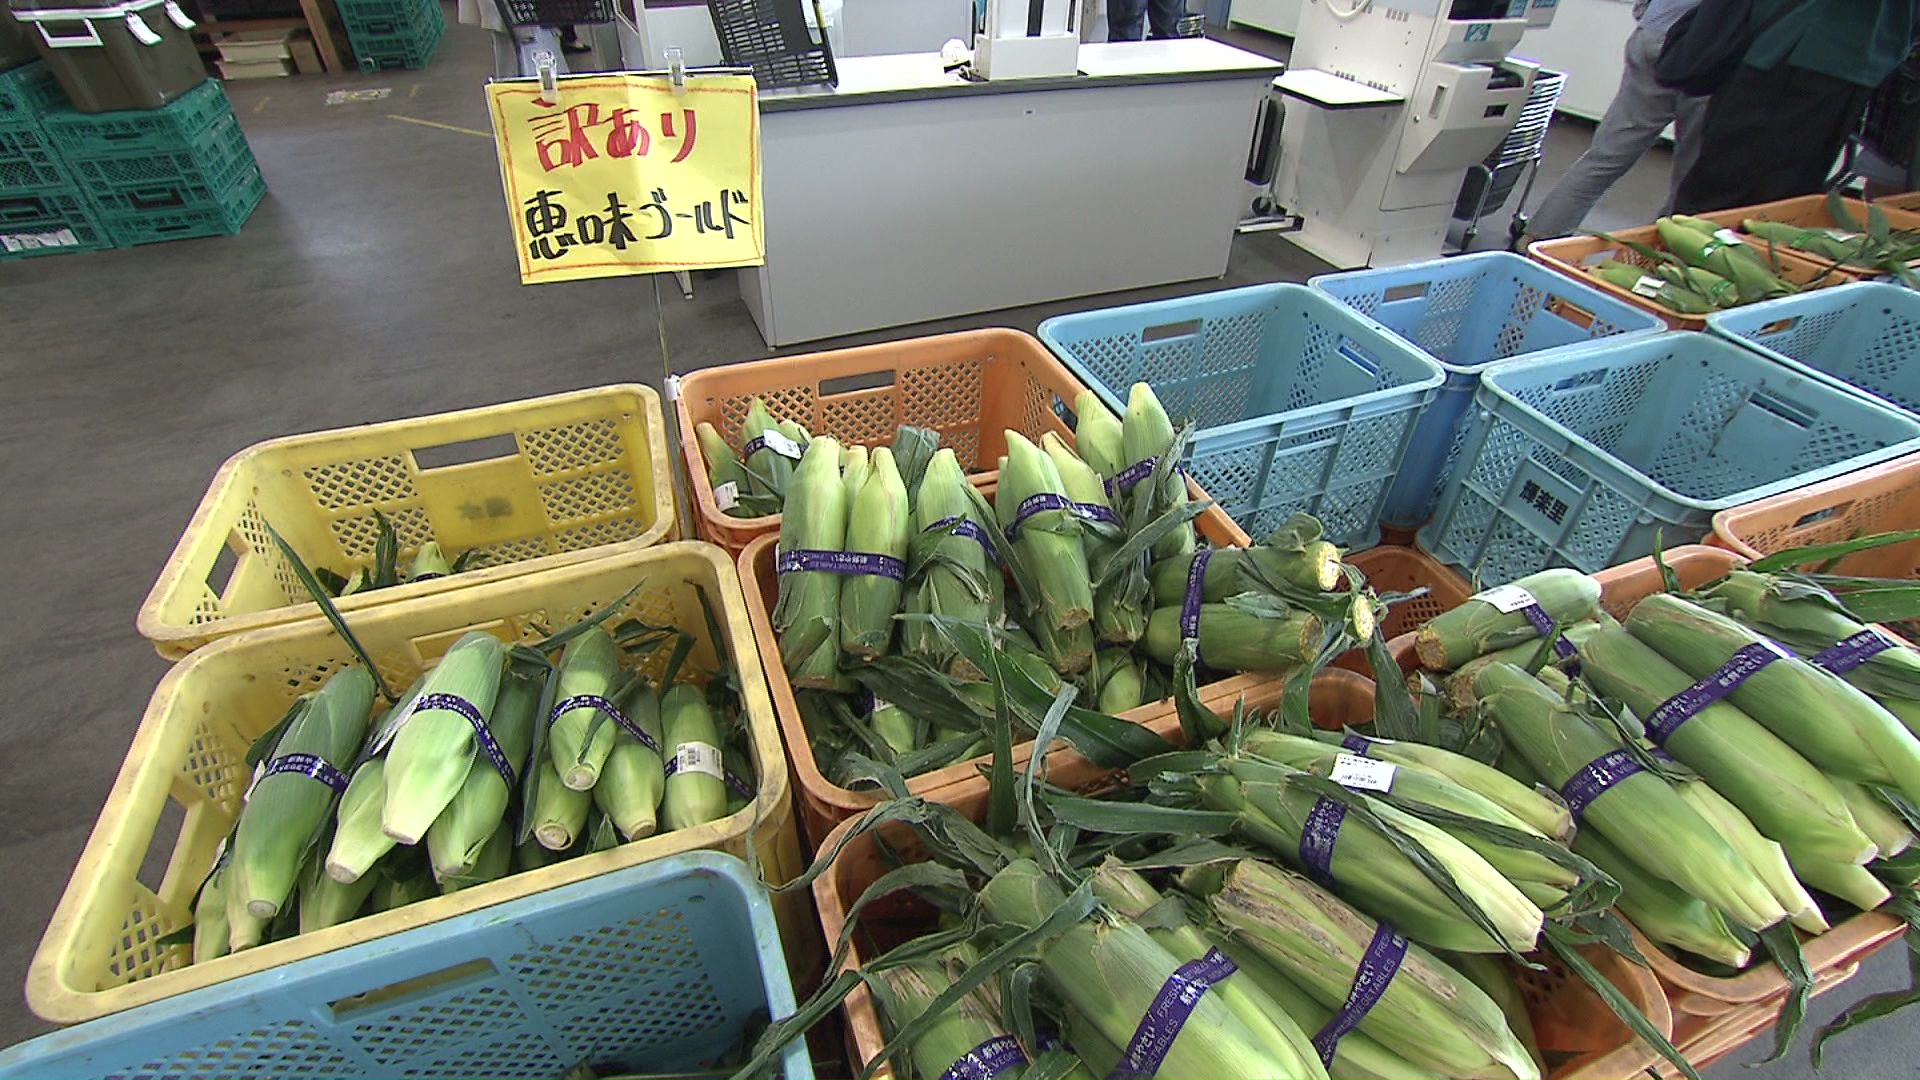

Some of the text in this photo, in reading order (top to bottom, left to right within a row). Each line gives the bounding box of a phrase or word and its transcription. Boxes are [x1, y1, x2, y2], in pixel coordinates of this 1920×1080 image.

[527, 97, 697, 173] 訳あり
[524, 187, 752, 260] 恵味ゴールド
